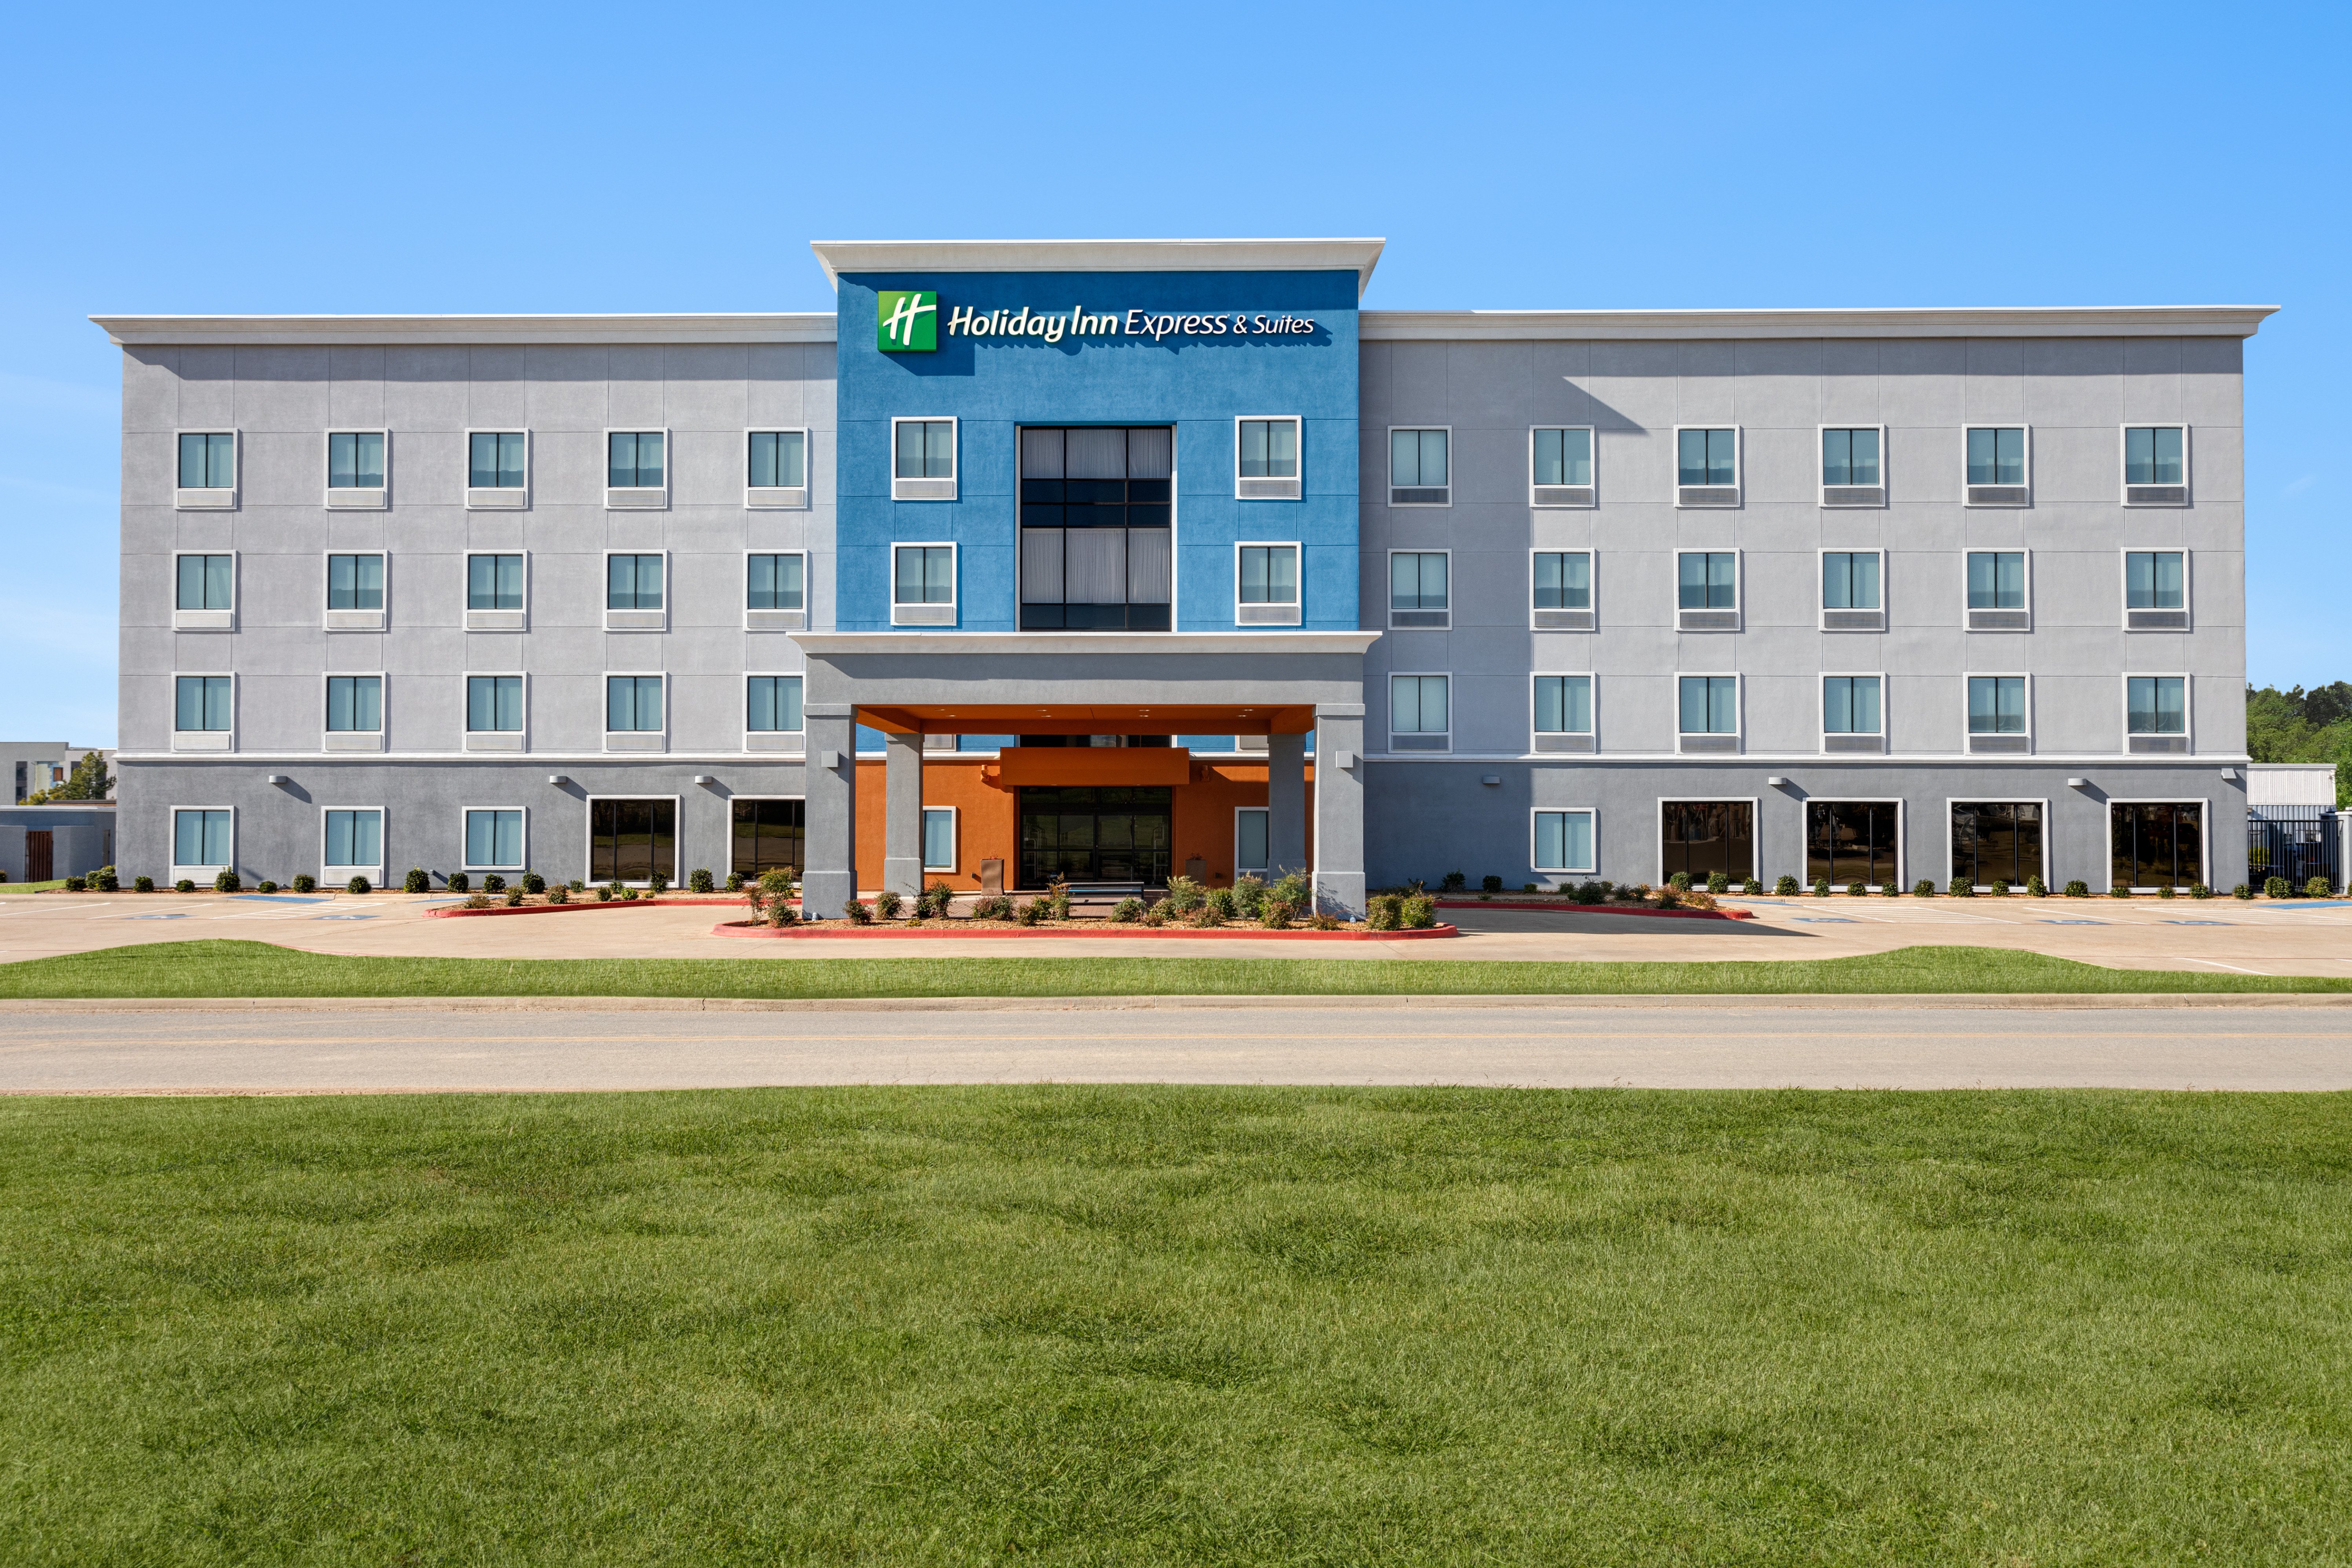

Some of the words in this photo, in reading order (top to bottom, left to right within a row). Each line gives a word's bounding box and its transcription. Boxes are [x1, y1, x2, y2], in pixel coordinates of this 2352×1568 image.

[882, 294, 936, 345] H
[947, 306, 1066, 342] Holiday
[1071, 305, 1118, 335] Inn
[1124, 309, 1228, 341] Express
[1233, 315, 1247, 334] &
[1252, 314, 1314, 334] Suites
